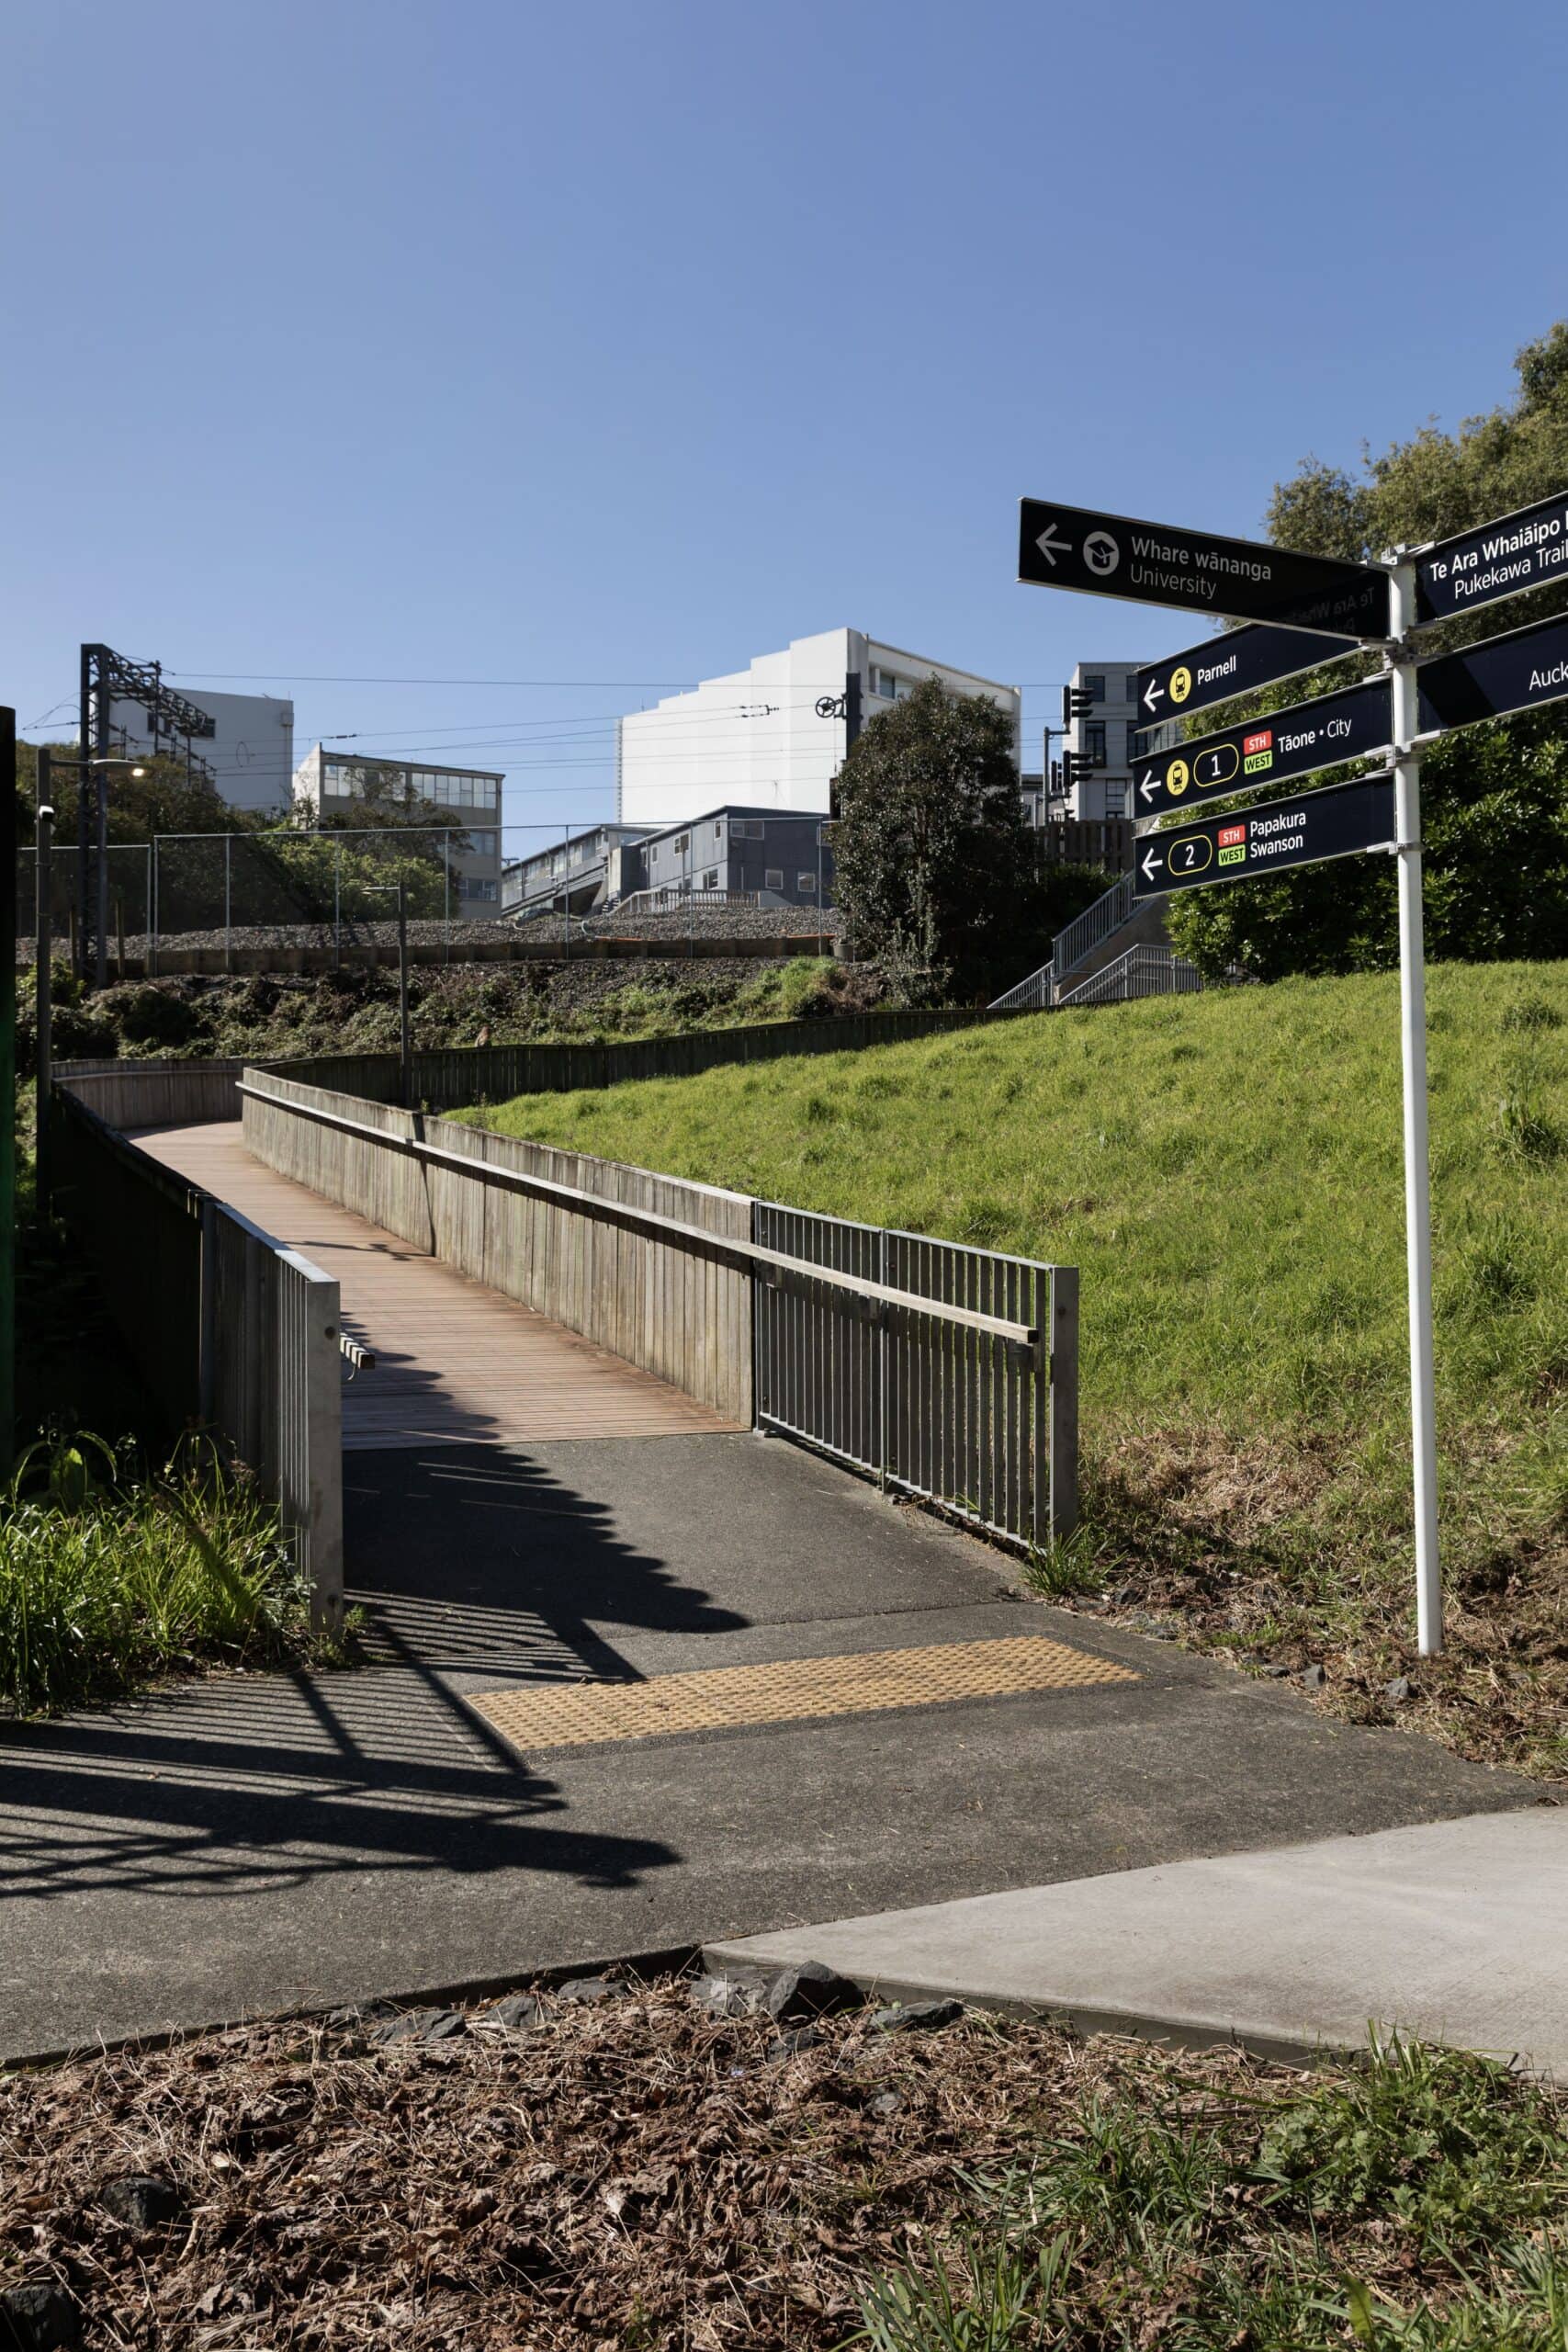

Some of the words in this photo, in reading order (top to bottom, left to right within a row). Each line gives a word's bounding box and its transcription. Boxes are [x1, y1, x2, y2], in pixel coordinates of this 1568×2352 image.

[1131, 536, 1190, 565] Whare
[1195, 551, 1272, 582] wānanga
[1430, 561, 1448, 582] Te
[1451, 551, 1478, 575] Ara
[1482, 519, 1561, 561] Whaiāipo
[1131, 563, 1217, 600] University
[1454, 558, 1532, 600] Pukekawa
[1536, 538, 1568, 569] Trail
[1197, 654, 1236, 685] Parnell
[1529, 661, 1568, 691] Auck
[1248, 737, 1267, 752] STH
[1278, 730, 1316, 753] Tāone
[1326, 718, 1352, 739] City
[1211, 754, 1221, 777] 1
[1246, 754, 1271, 772] WEST
[1223, 830, 1240, 843] STH
[1250, 812, 1306, 838] Papakura
[1185, 844, 1195, 866] 2
[1220, 848, 1244, 864] WEST
[1250, 834, 1303, 859] Swanson
